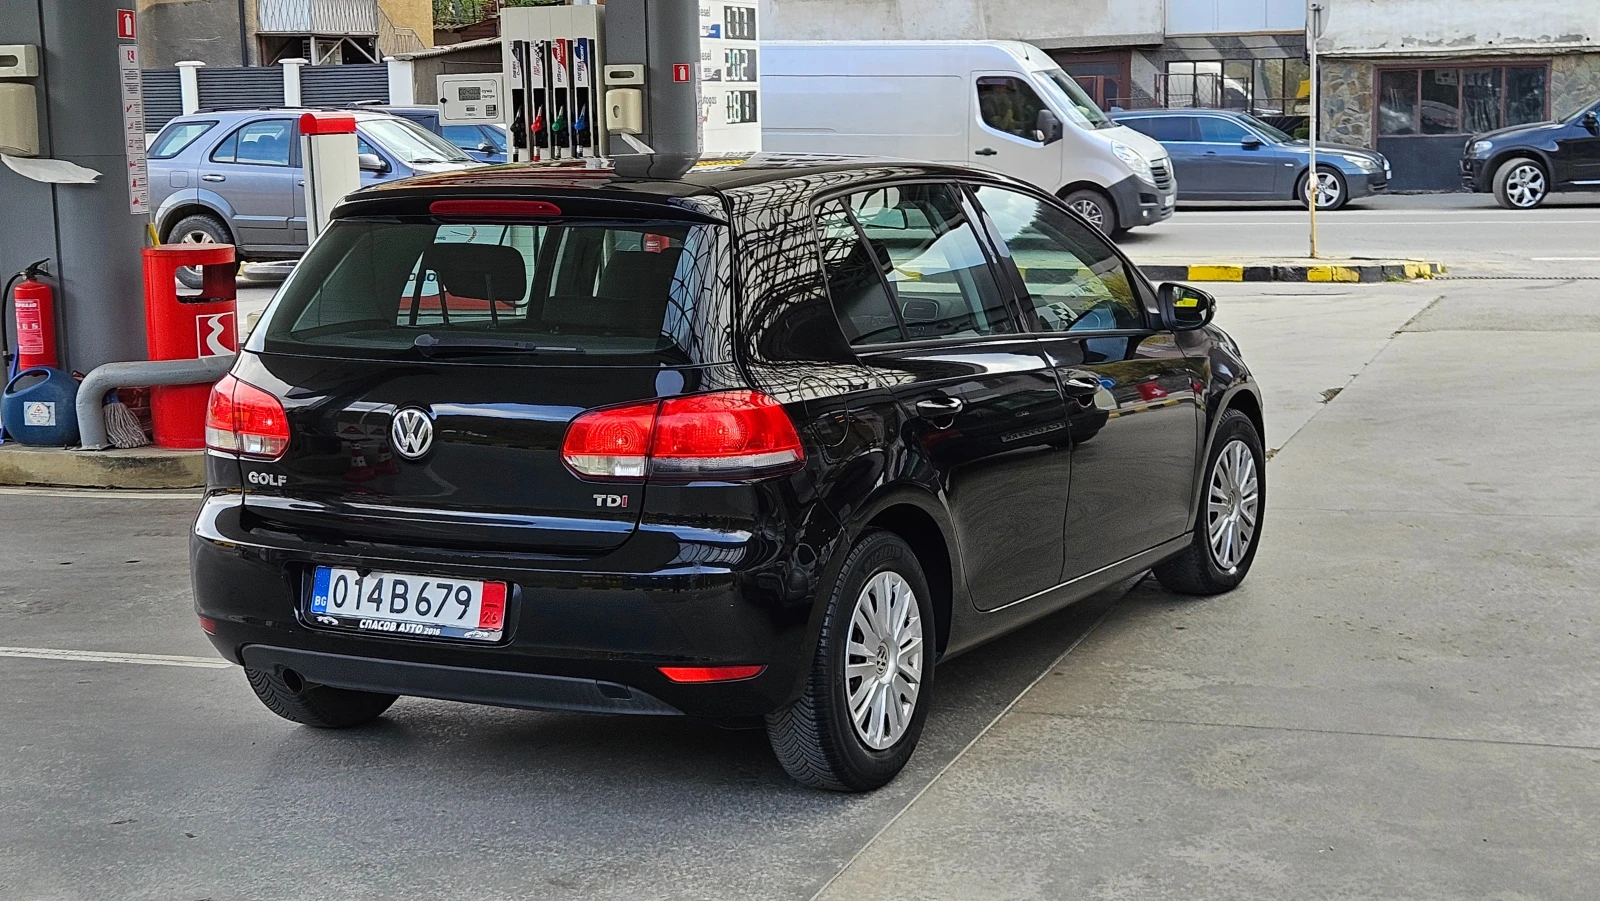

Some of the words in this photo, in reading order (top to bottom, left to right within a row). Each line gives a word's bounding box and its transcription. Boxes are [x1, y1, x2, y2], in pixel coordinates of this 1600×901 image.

[248, 471, 287, 486] GOLF
[593, 494, 628, 507] TDI
[314, 595, 327, 607] BG
[359, 619, 396, 632] СПАСОВ
[398, 622, 424, 633] АУТО
[424, 627, 441, 636] 2016
